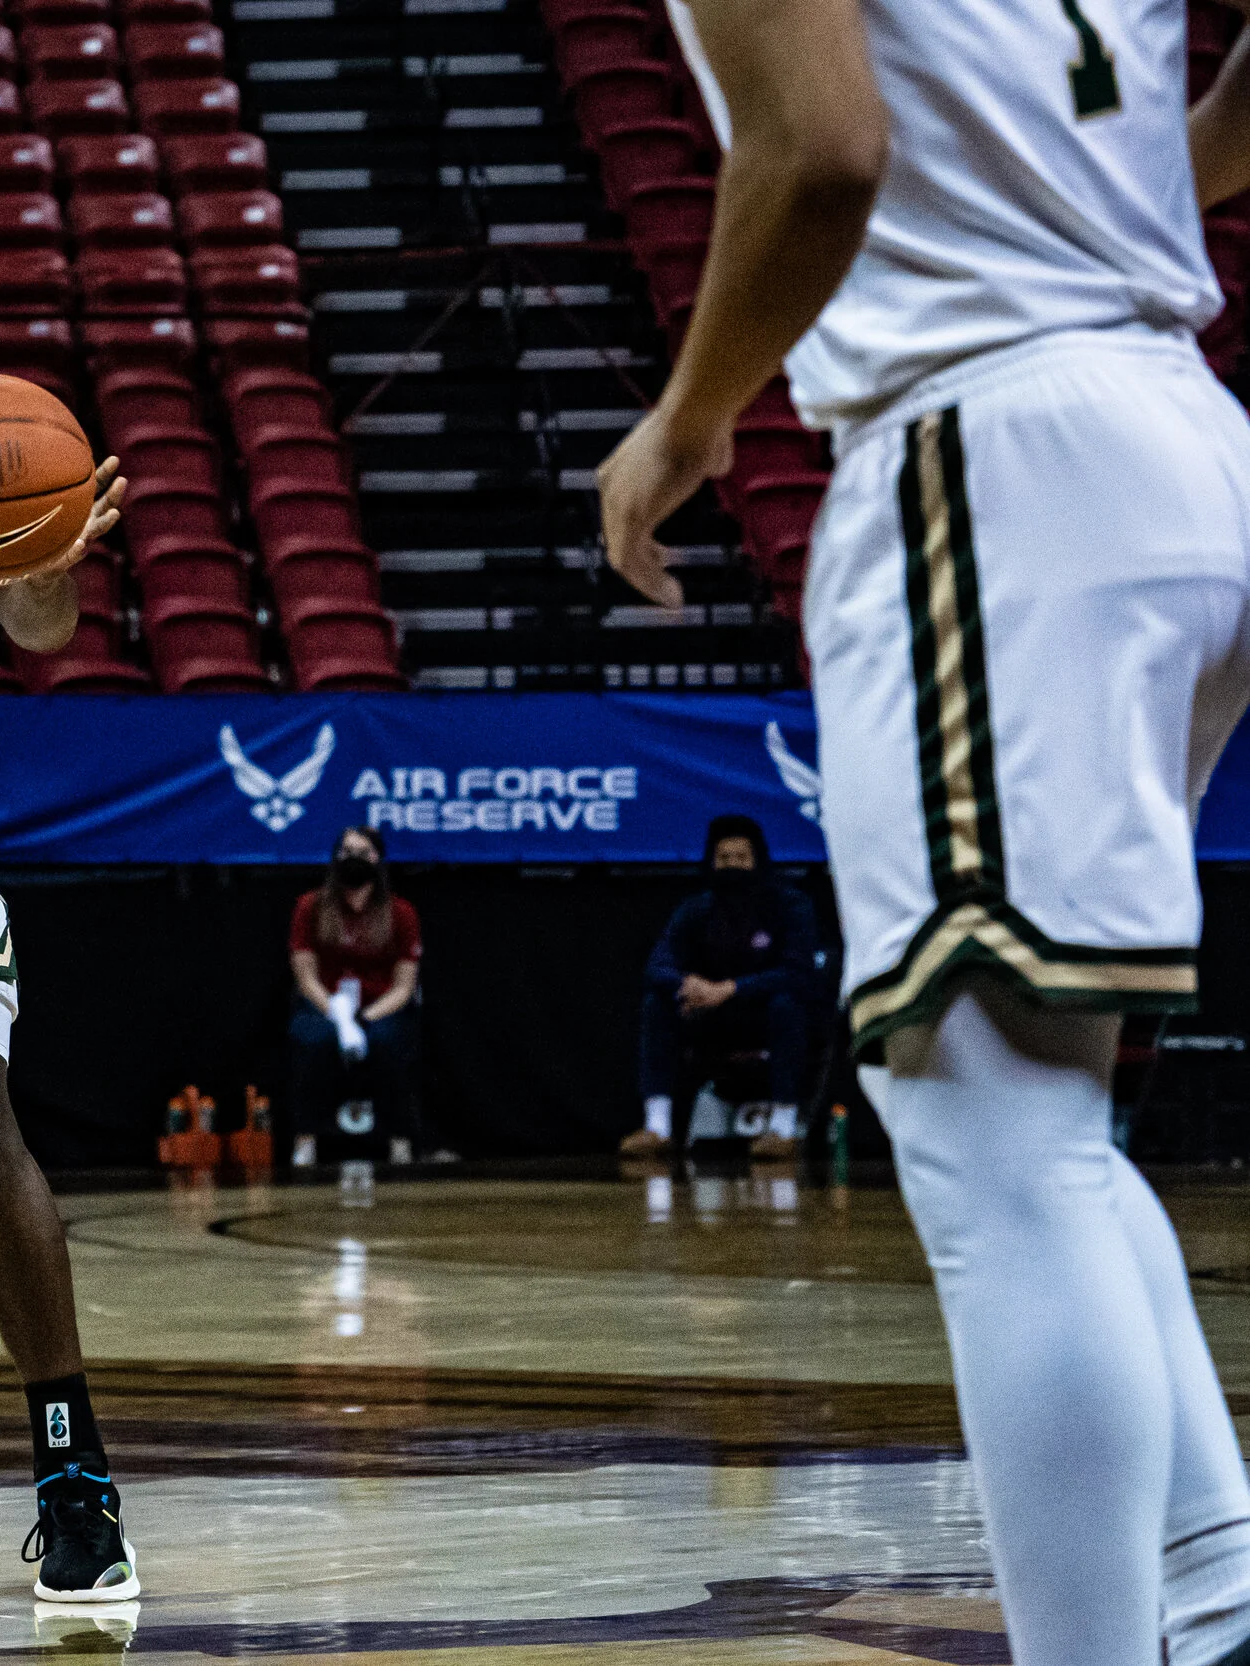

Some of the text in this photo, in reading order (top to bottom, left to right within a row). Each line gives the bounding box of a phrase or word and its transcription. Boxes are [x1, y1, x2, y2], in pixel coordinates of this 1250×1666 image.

[351, 766, 638, 800] AIR FORCE
[367, 800, 620, 832] RESERVE
